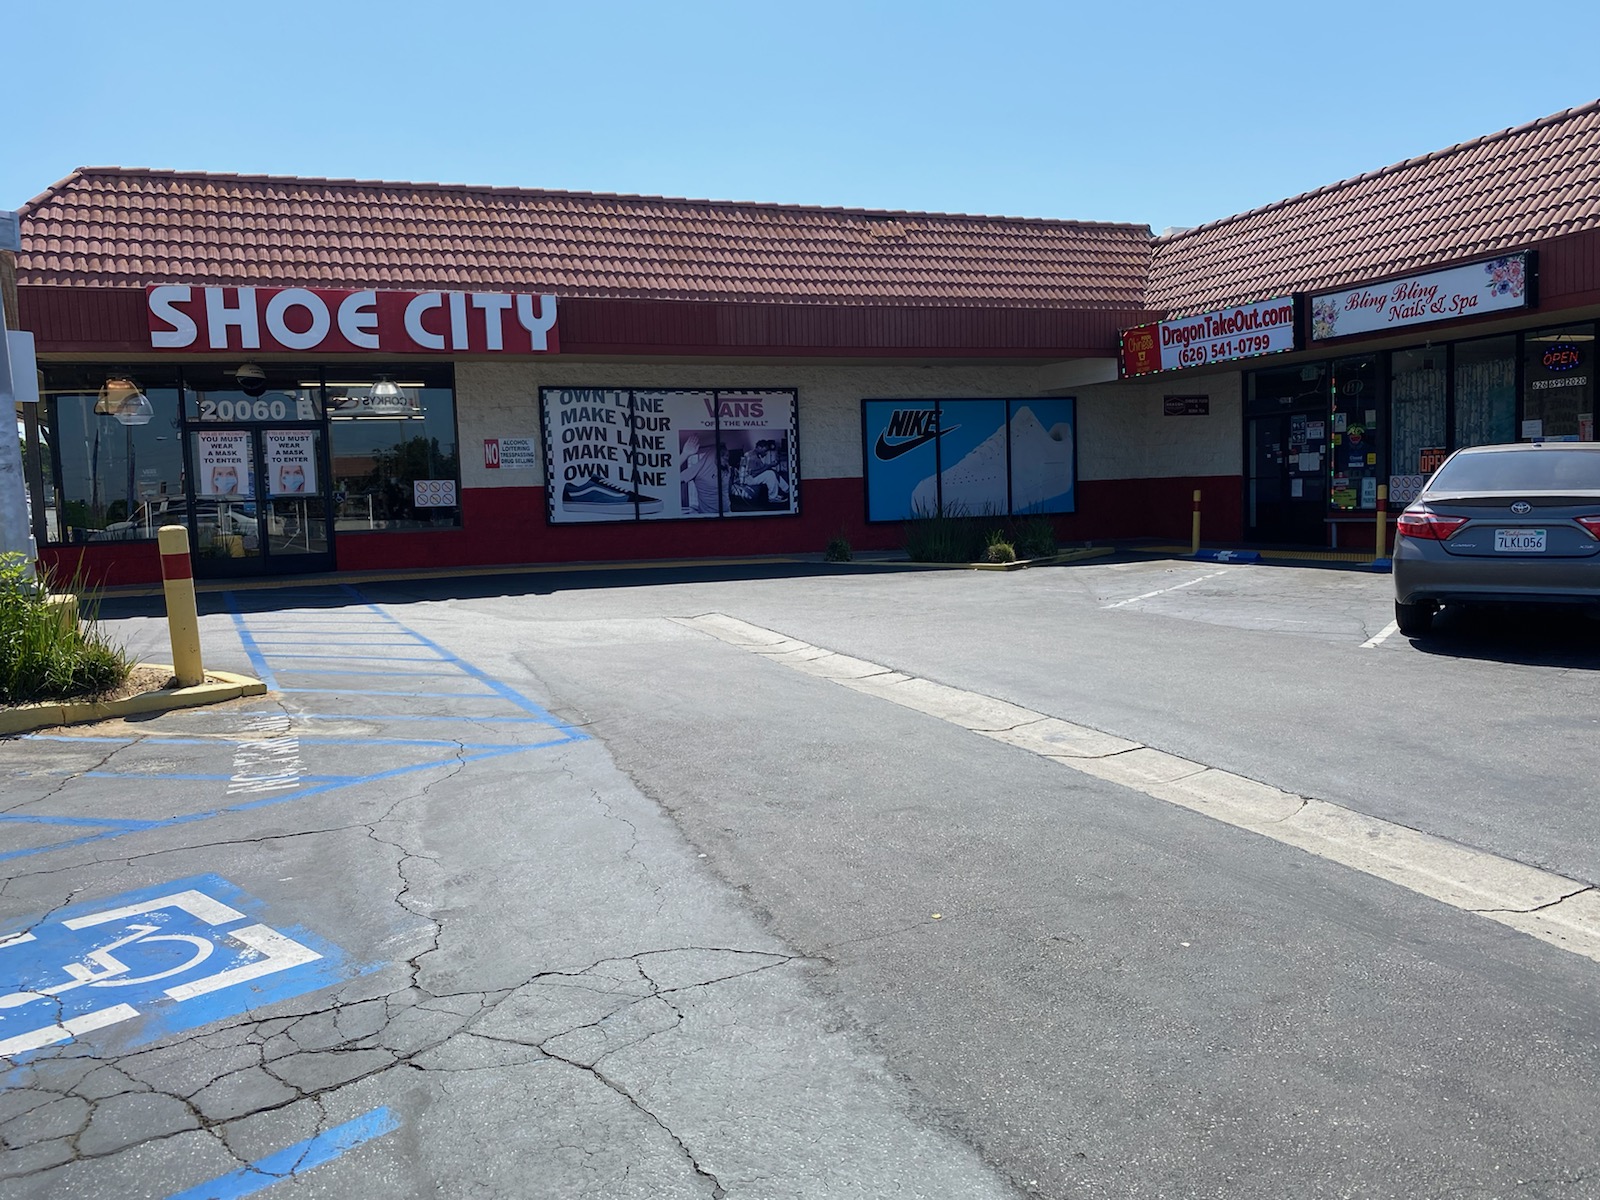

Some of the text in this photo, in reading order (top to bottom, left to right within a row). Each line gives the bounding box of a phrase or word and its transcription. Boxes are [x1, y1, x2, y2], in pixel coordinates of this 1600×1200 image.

[1345, 281, 1439, 313] Bling Bling
[1388, 293, 1479, 322] Nails & Spa
[147, 285, 558, 352] SHOE CITY
[1162, 305, 1293, 348] DragonTakeOut.com
[1178, 333, 1270, 368] (626) 541-0799
[1542, 351, 1580, 366] OPEN
[1532, 380, 1549, 390] 626
[1565, 376, 1588, 388] 2020
[200, 400, 287, 420] 20060
[559, 389, 665, 413] OWN LANE
[703, 398, 765, 419] VANS
[561, 406, 671, 432] MAKE YOUR
[701, 420, 769, 428] "OF THE WALL"
[886, 409, 944, 437] NIKE
[562, 426, 666, 451] OWN LANE
[485, 443, 499, 465] NO
[563, 444, 673, 468] MAKE YOUR
[564, 463, 668, 487] OWN LANE
[1498, 537, 1543, 548] 7LKL056
